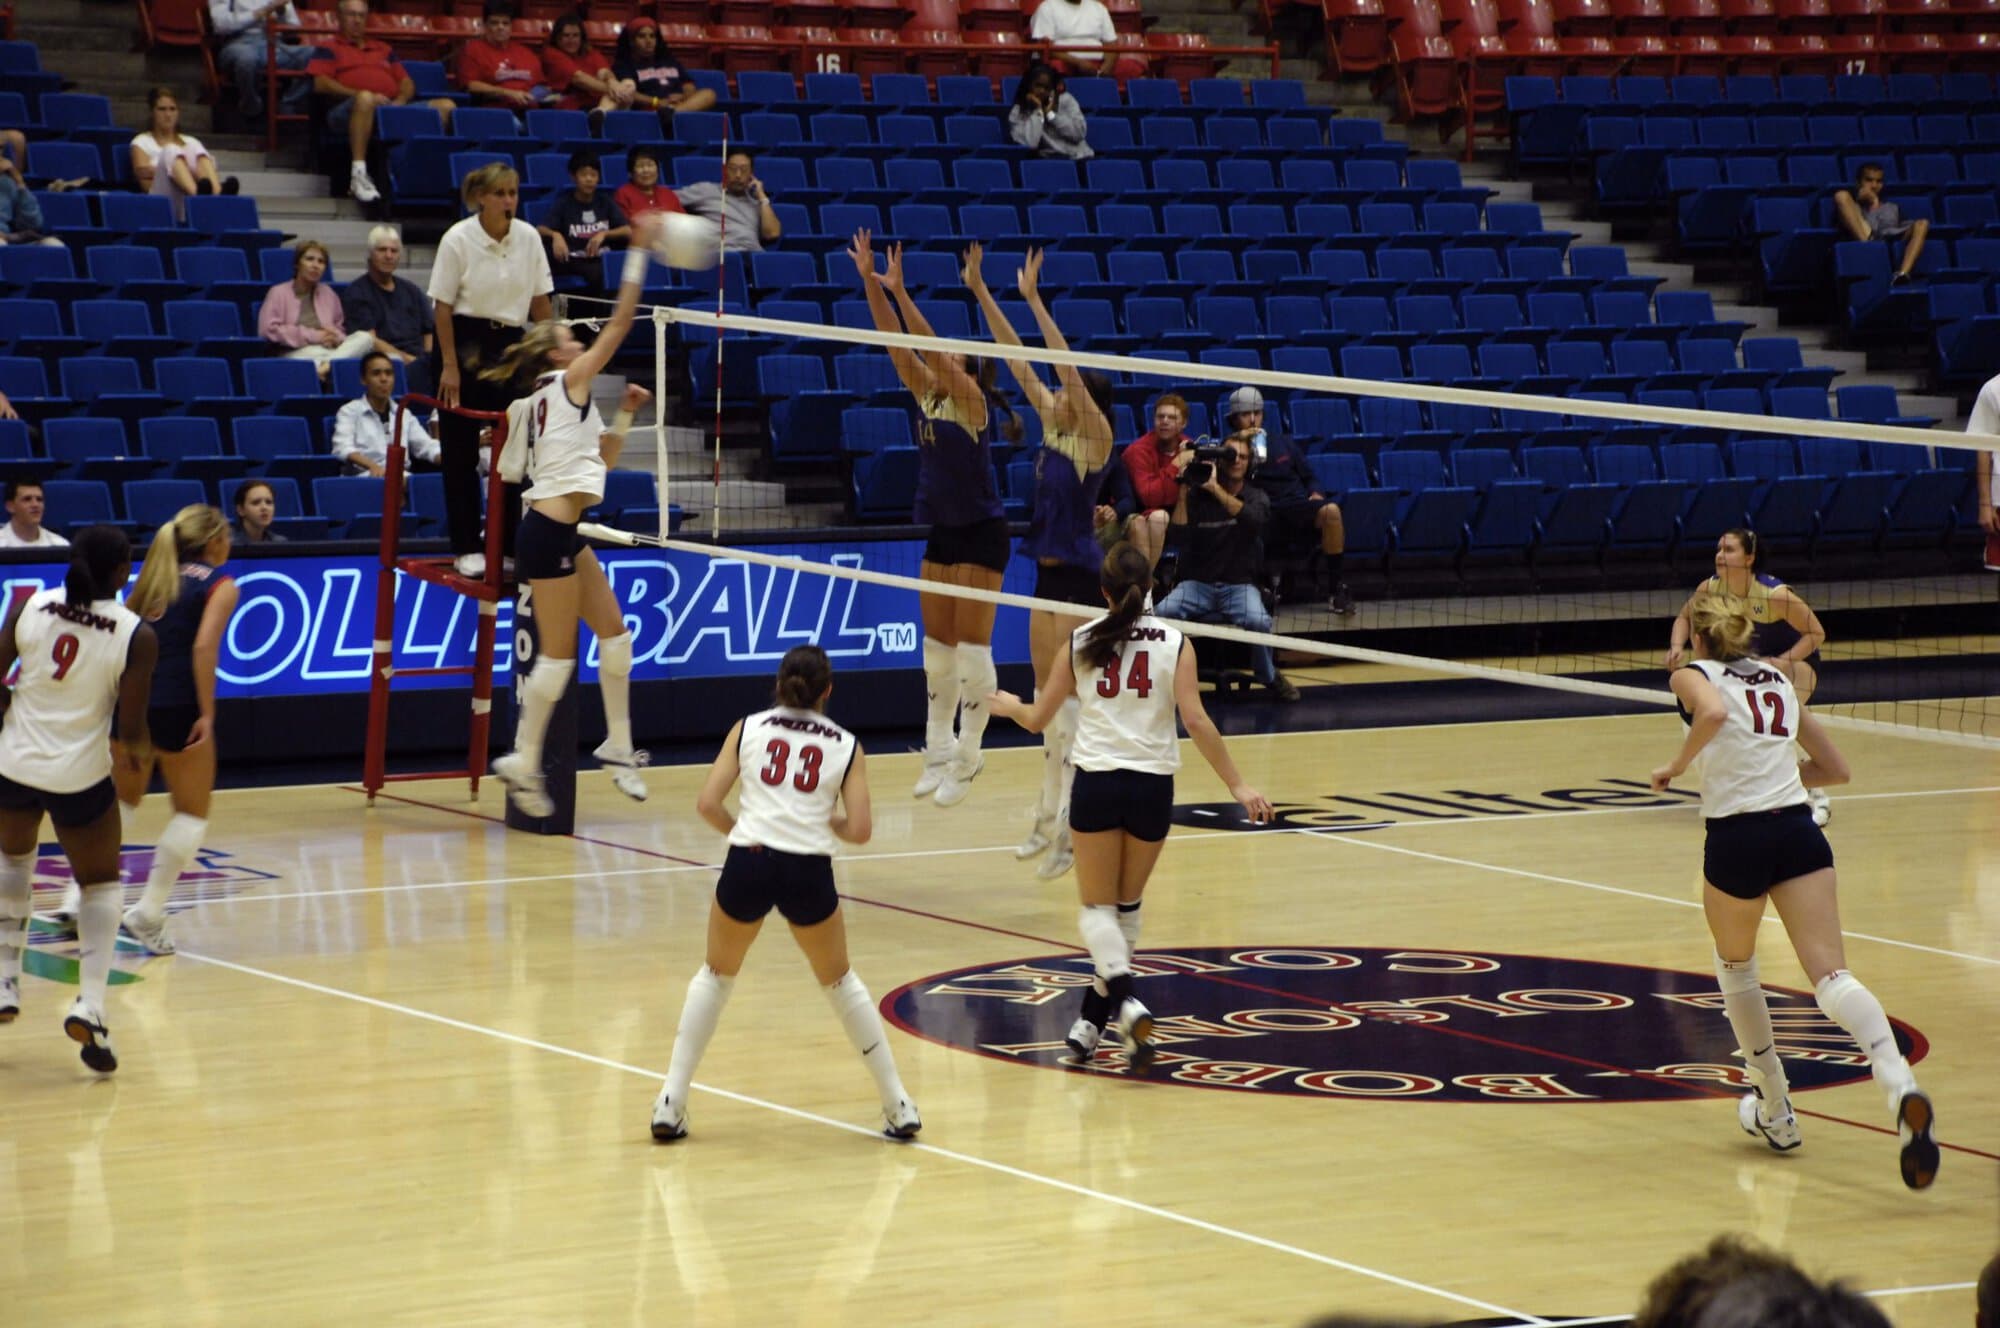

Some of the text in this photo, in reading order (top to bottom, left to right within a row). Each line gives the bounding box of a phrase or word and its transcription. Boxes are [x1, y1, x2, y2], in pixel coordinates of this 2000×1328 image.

[816, 53, 841, 74] 16
[1846, 59, 1866, 76] 17
[51, 632, 80, 681] 9
[1097, 651, 1153, 699] 34
[760, 715, 842, 743] ARIZONA
[1745, 689, 1789, 738] 12
[760, 738, 824, 794] 33
